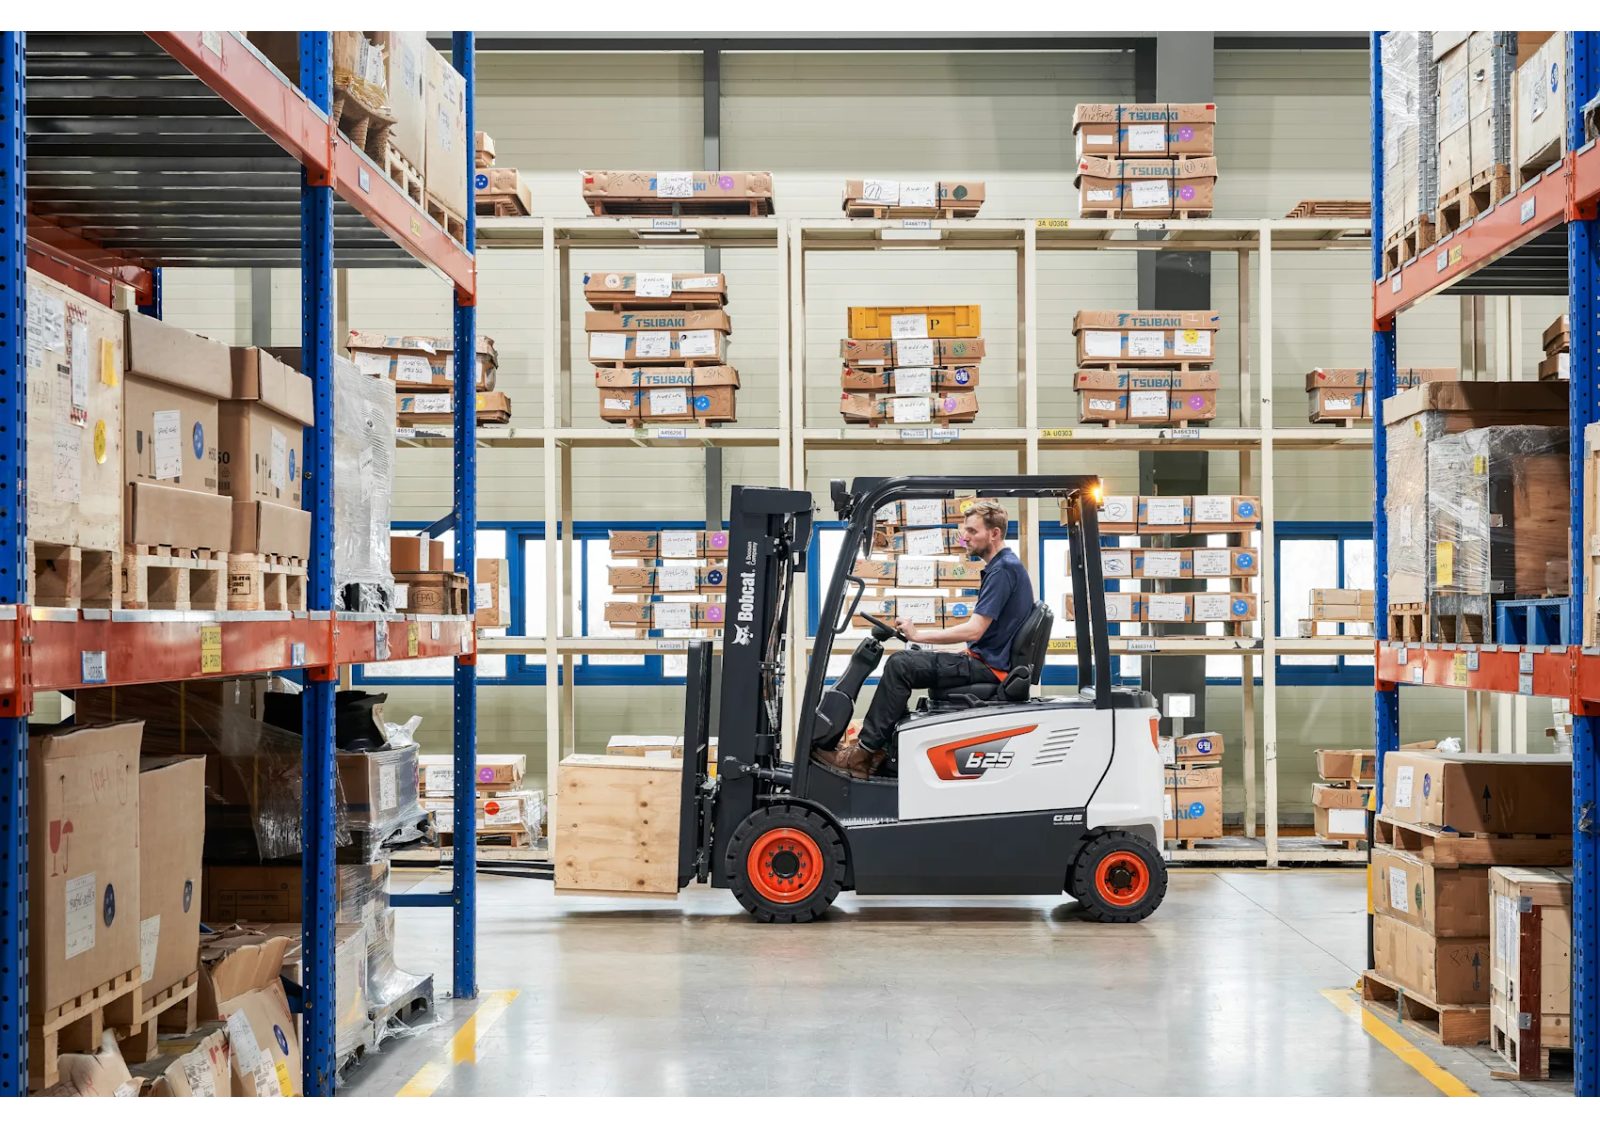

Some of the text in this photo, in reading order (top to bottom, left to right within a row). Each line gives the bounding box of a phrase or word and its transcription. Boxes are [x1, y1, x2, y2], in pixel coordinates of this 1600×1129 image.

[1128, 112, 1178, 121] TSUBAKI
[1131, 167, 1181, 176] TSUBAKI
[635, 318, 686, 328] TSUBAKI
[930, 319, 940, 331] P
[1131, 317, 1182, 327] TSUBAKI
[1132, 378, 1182, 388] TSUBAKI
[738, 572, 756, 621] Bobcat
[964, 751, 1016, 769] B25
